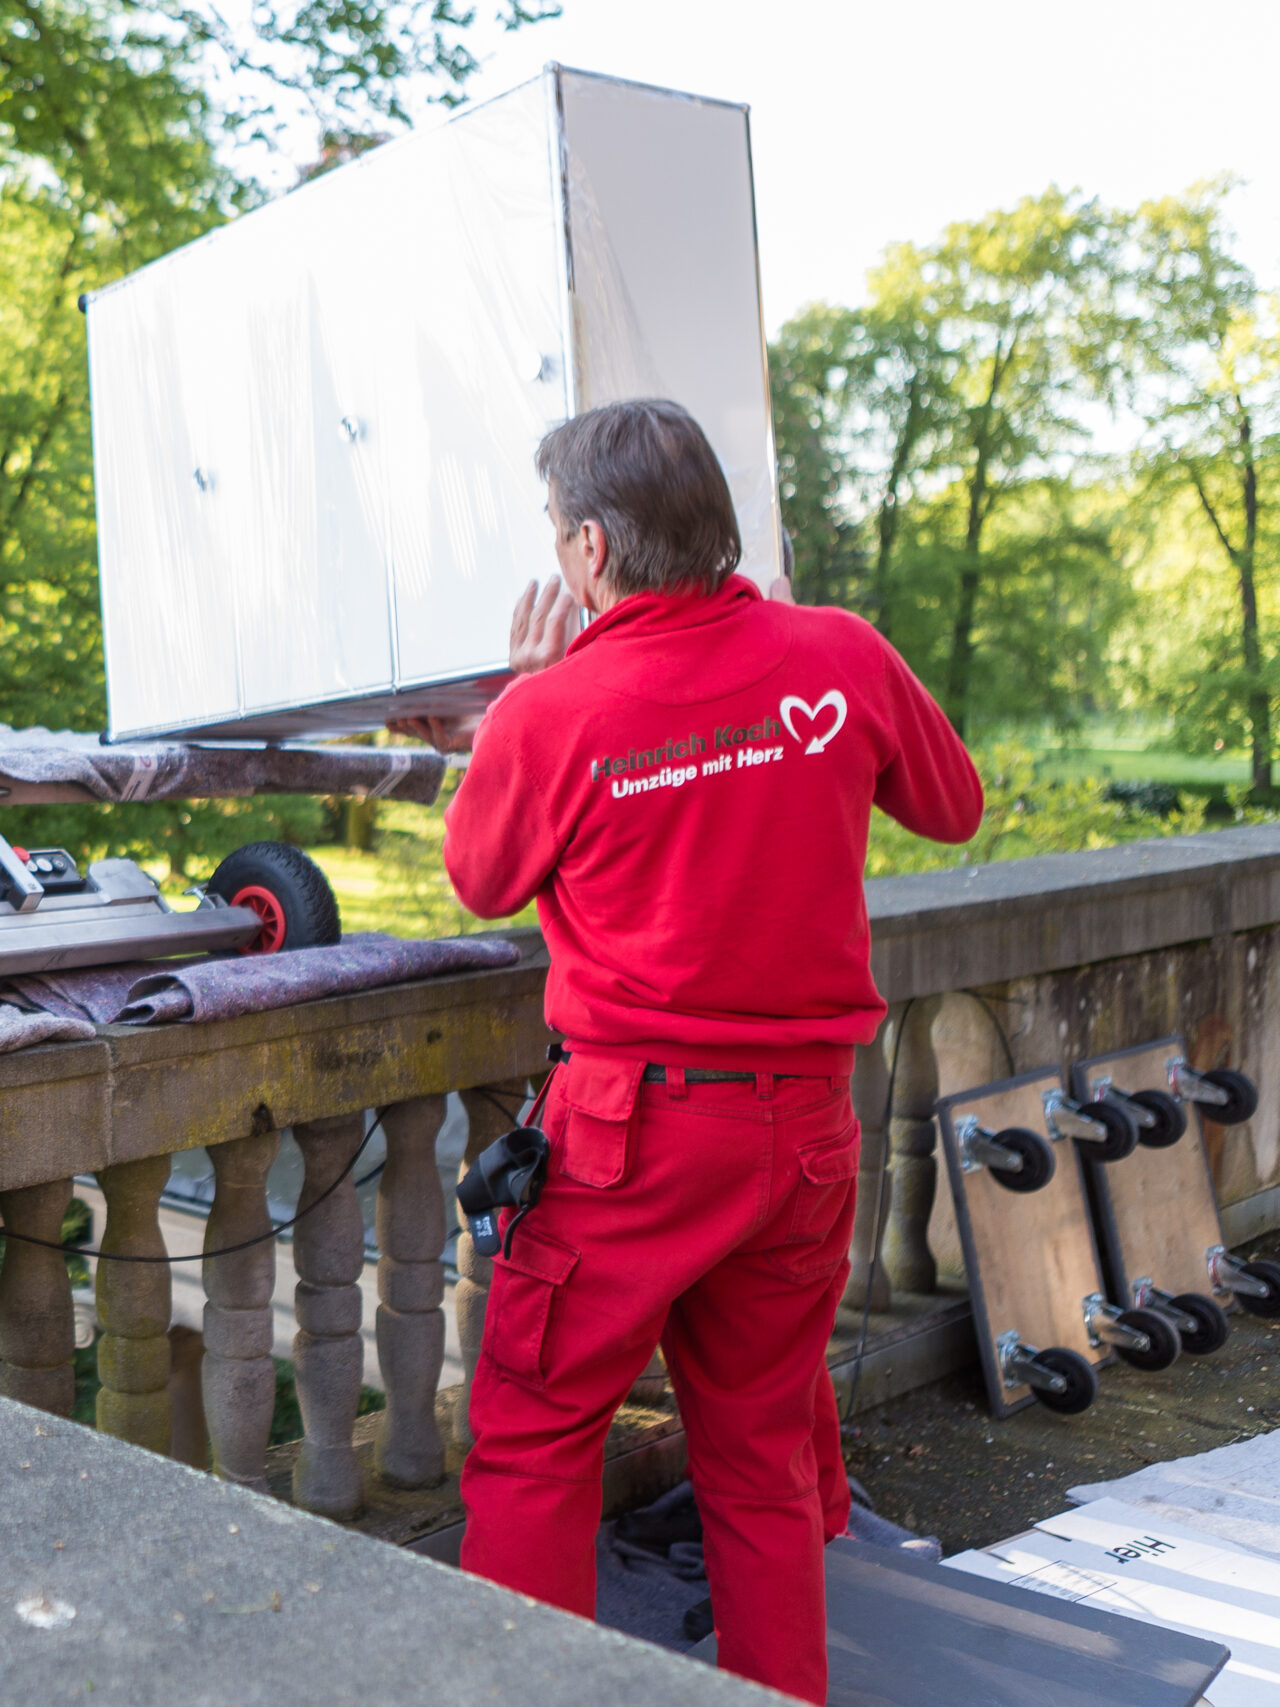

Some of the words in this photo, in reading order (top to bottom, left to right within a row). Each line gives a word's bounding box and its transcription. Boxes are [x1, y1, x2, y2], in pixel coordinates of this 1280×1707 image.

[591, 733, 706, 781] Heinrich
[714, 716, 781, 749] Koch
[611, 763, 697, 798] Umzüge
[702, 754, 732, 777] mit
[736, 745, 783, 769] Herz
[1104, 1535, 1177, 1564] Hier
